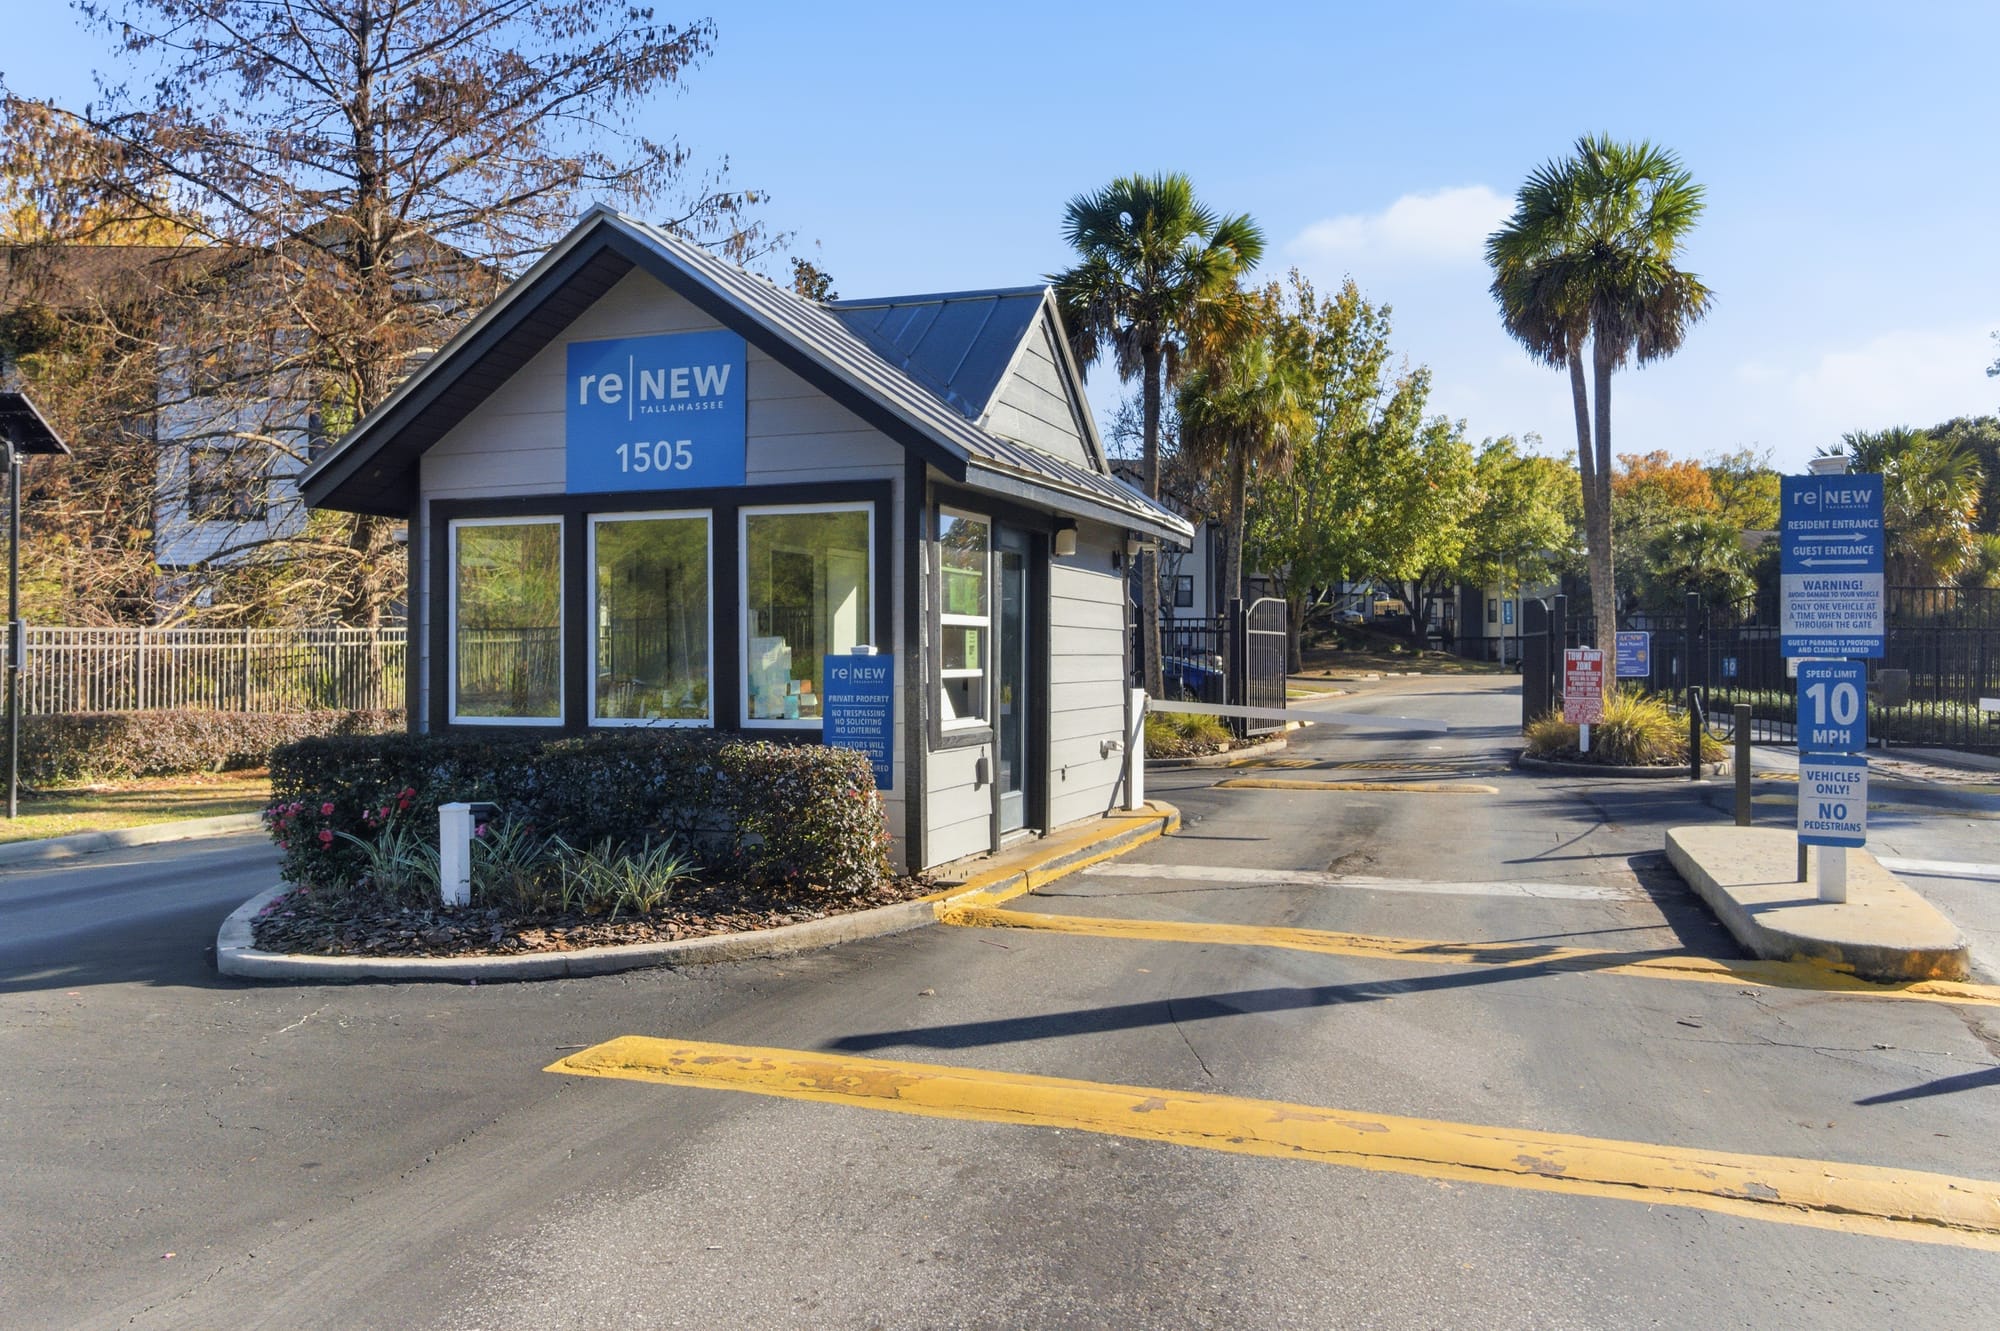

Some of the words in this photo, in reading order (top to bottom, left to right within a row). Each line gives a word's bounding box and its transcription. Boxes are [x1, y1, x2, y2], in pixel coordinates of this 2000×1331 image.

[579, 373, 624, 405] re
[640, 364, 731, 401] NEW
[640, 401, 724, 414] TALLAHASSEE
[615, 439, 693, 473] 1505
[1793, 491, 1817, 505] re
[1825, 489, 1872, 504] NEW
[1787, 520, 1830, 530] RESIDENT
[1832, 519, 1879, 529] ENTRANCE
[1792, 546, 1822, 556] GUEST
[1825, 545, 1874, 555] ENTRANCE
[1803, 580, 1863, 591] WARNING!
[1791, 603, 1811, 611] ONLY
[1813, 603, 1830, 611] ONE
[1831, 603, 1864, 611] VEHICLE
[1866, 602, 1876, 610] AT
[1789, 612, 1795, 620] A
[1796, 612, 1816, 620] TIME
[1817, 612, 1842, 620] WHEN
[1844, 612, 1878, 620] DRIVING
[1795, 621, 1833, 629] THROUGH
[1835, 621, 1850, 629] THE
[1852, 621, 1872, 629] GATE
[1846, 639, 1879, 647] PROVIDED
[853, 668, 886, 679] NEW
[1806, 670, 1831, 678] SPEED
[1834, 670, 1857, 678] LIMIT
[828, 695, 854, 703] PRIVATE
[856, 695, 889, 703] PROPERTY
[1805, 682, 1859, 725] 10
[831, 709, 841, 717] NO
[843, 709, 886, 717] TRESPASSING
[846, 718, 882, 726] SOLICITING
[1812, 729, 1851, 744] MPH
[869, 741, 885, 749] WILL
[1806, 771, 1860, 783] VEHICLES
[1816, 784, 1850, 795] ONLY!
[1818, 803, 1847, 820] NO
[1804, 820, 1861, 832] PEDESTRIANS
